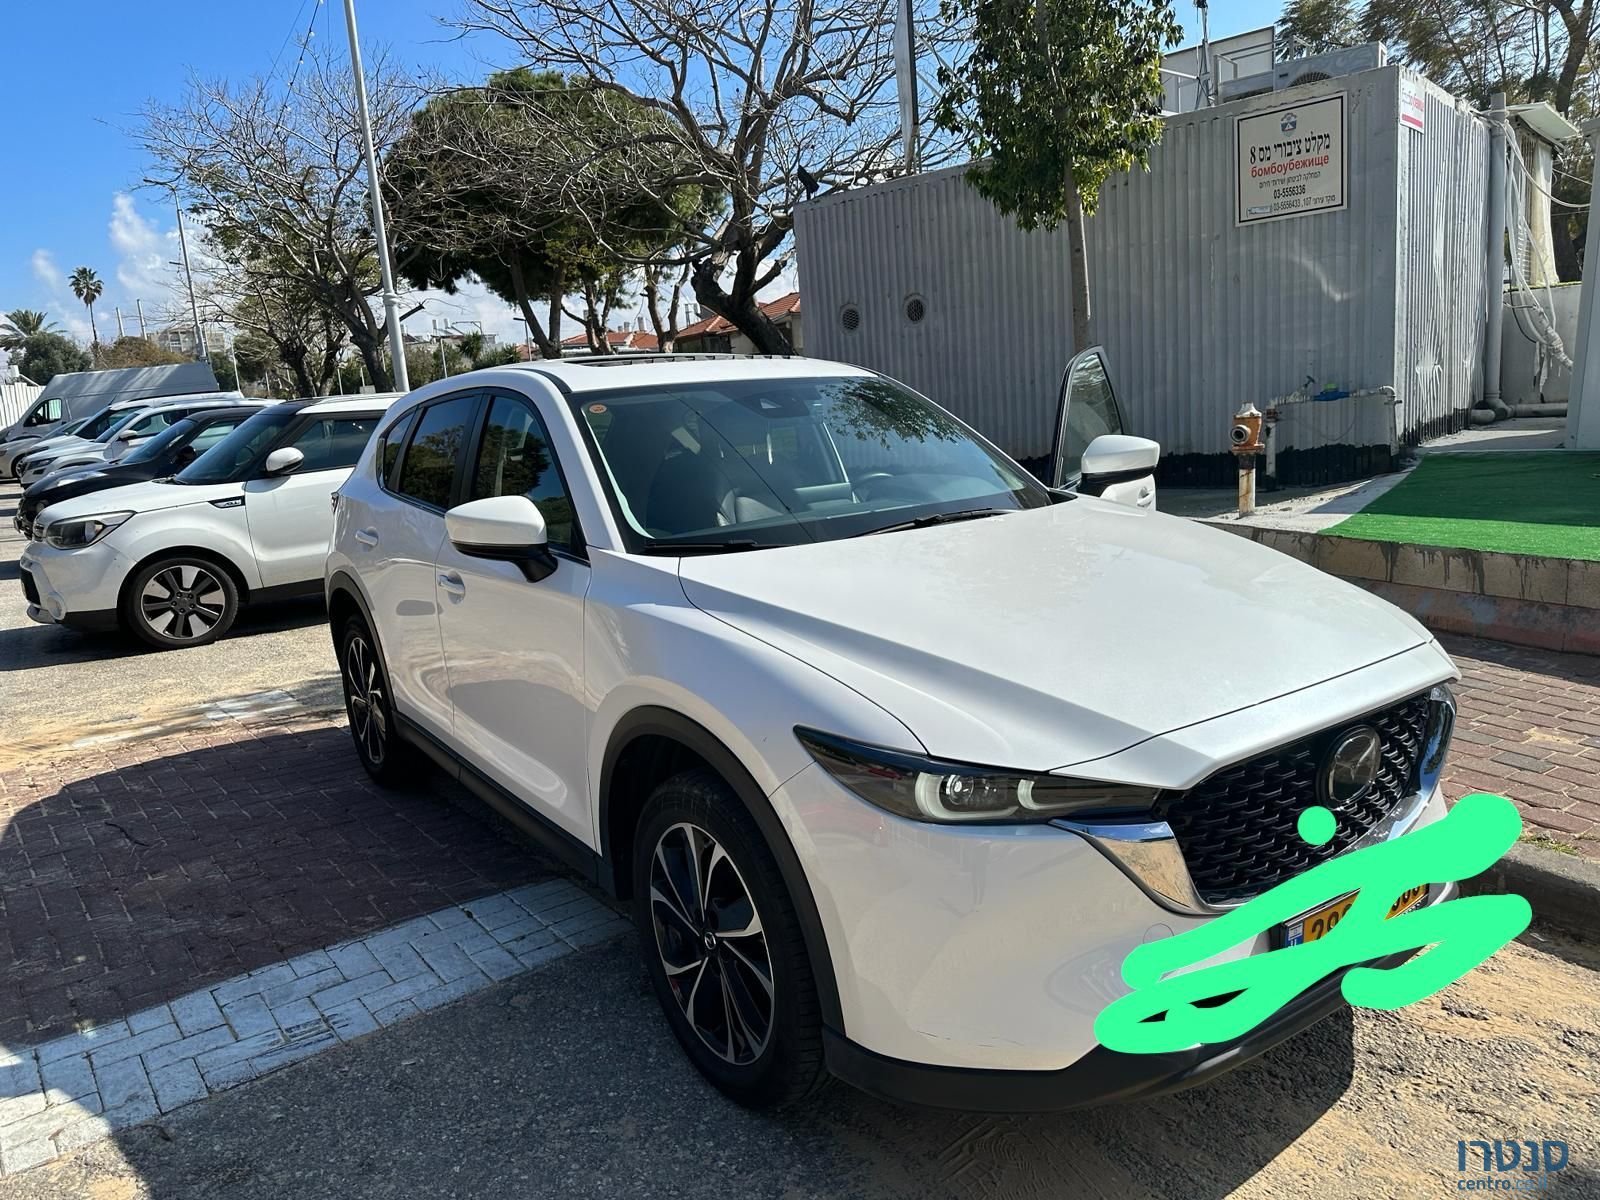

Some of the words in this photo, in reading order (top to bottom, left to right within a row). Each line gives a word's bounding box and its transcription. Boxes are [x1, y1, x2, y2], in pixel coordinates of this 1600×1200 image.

[1274, 138, 1302, 158] ציבורי
[1304, 131, 1331, 155] מקלט
[1250, 145, 1256, 164] 8
[1258, 145, 1271, 162] מס
[1251, 154, 1330, 178] бомбоубежище
[1273, 184, 1306, 200] 03-5556336
